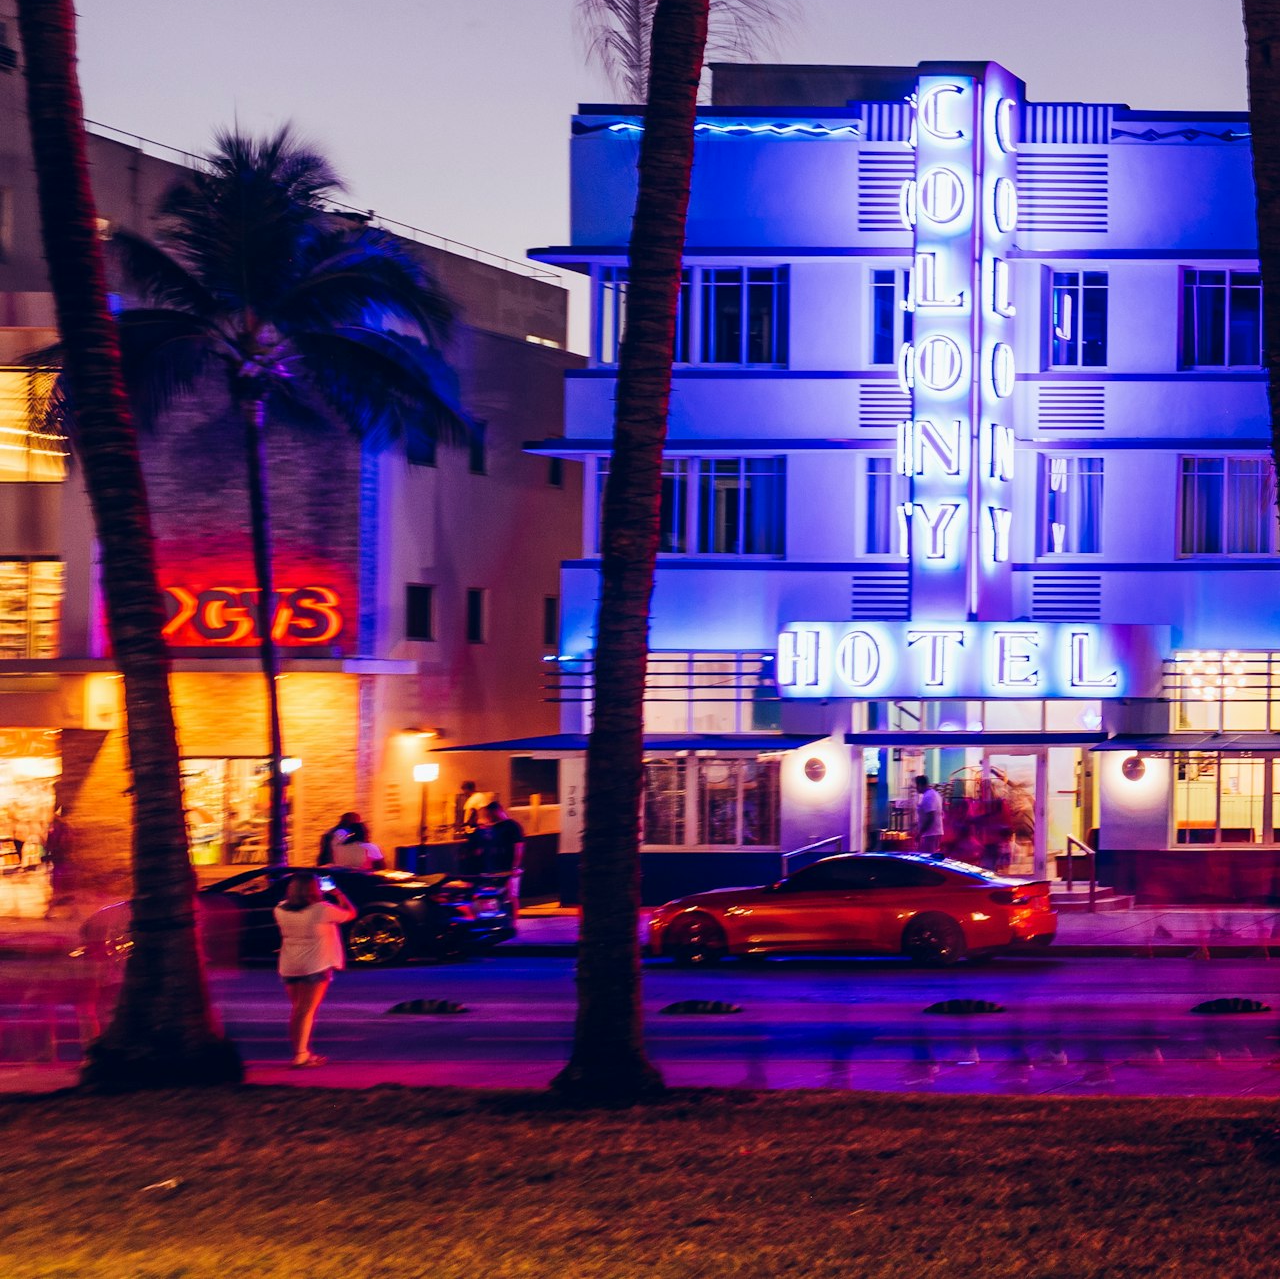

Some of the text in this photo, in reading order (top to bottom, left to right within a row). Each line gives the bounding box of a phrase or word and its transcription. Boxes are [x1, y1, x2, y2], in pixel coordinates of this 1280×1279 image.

[914, 83, 966, 559] COLONY
[988, 97, 1018, 562] COLONY
[777, 630, 1118, 687] HOTEL
